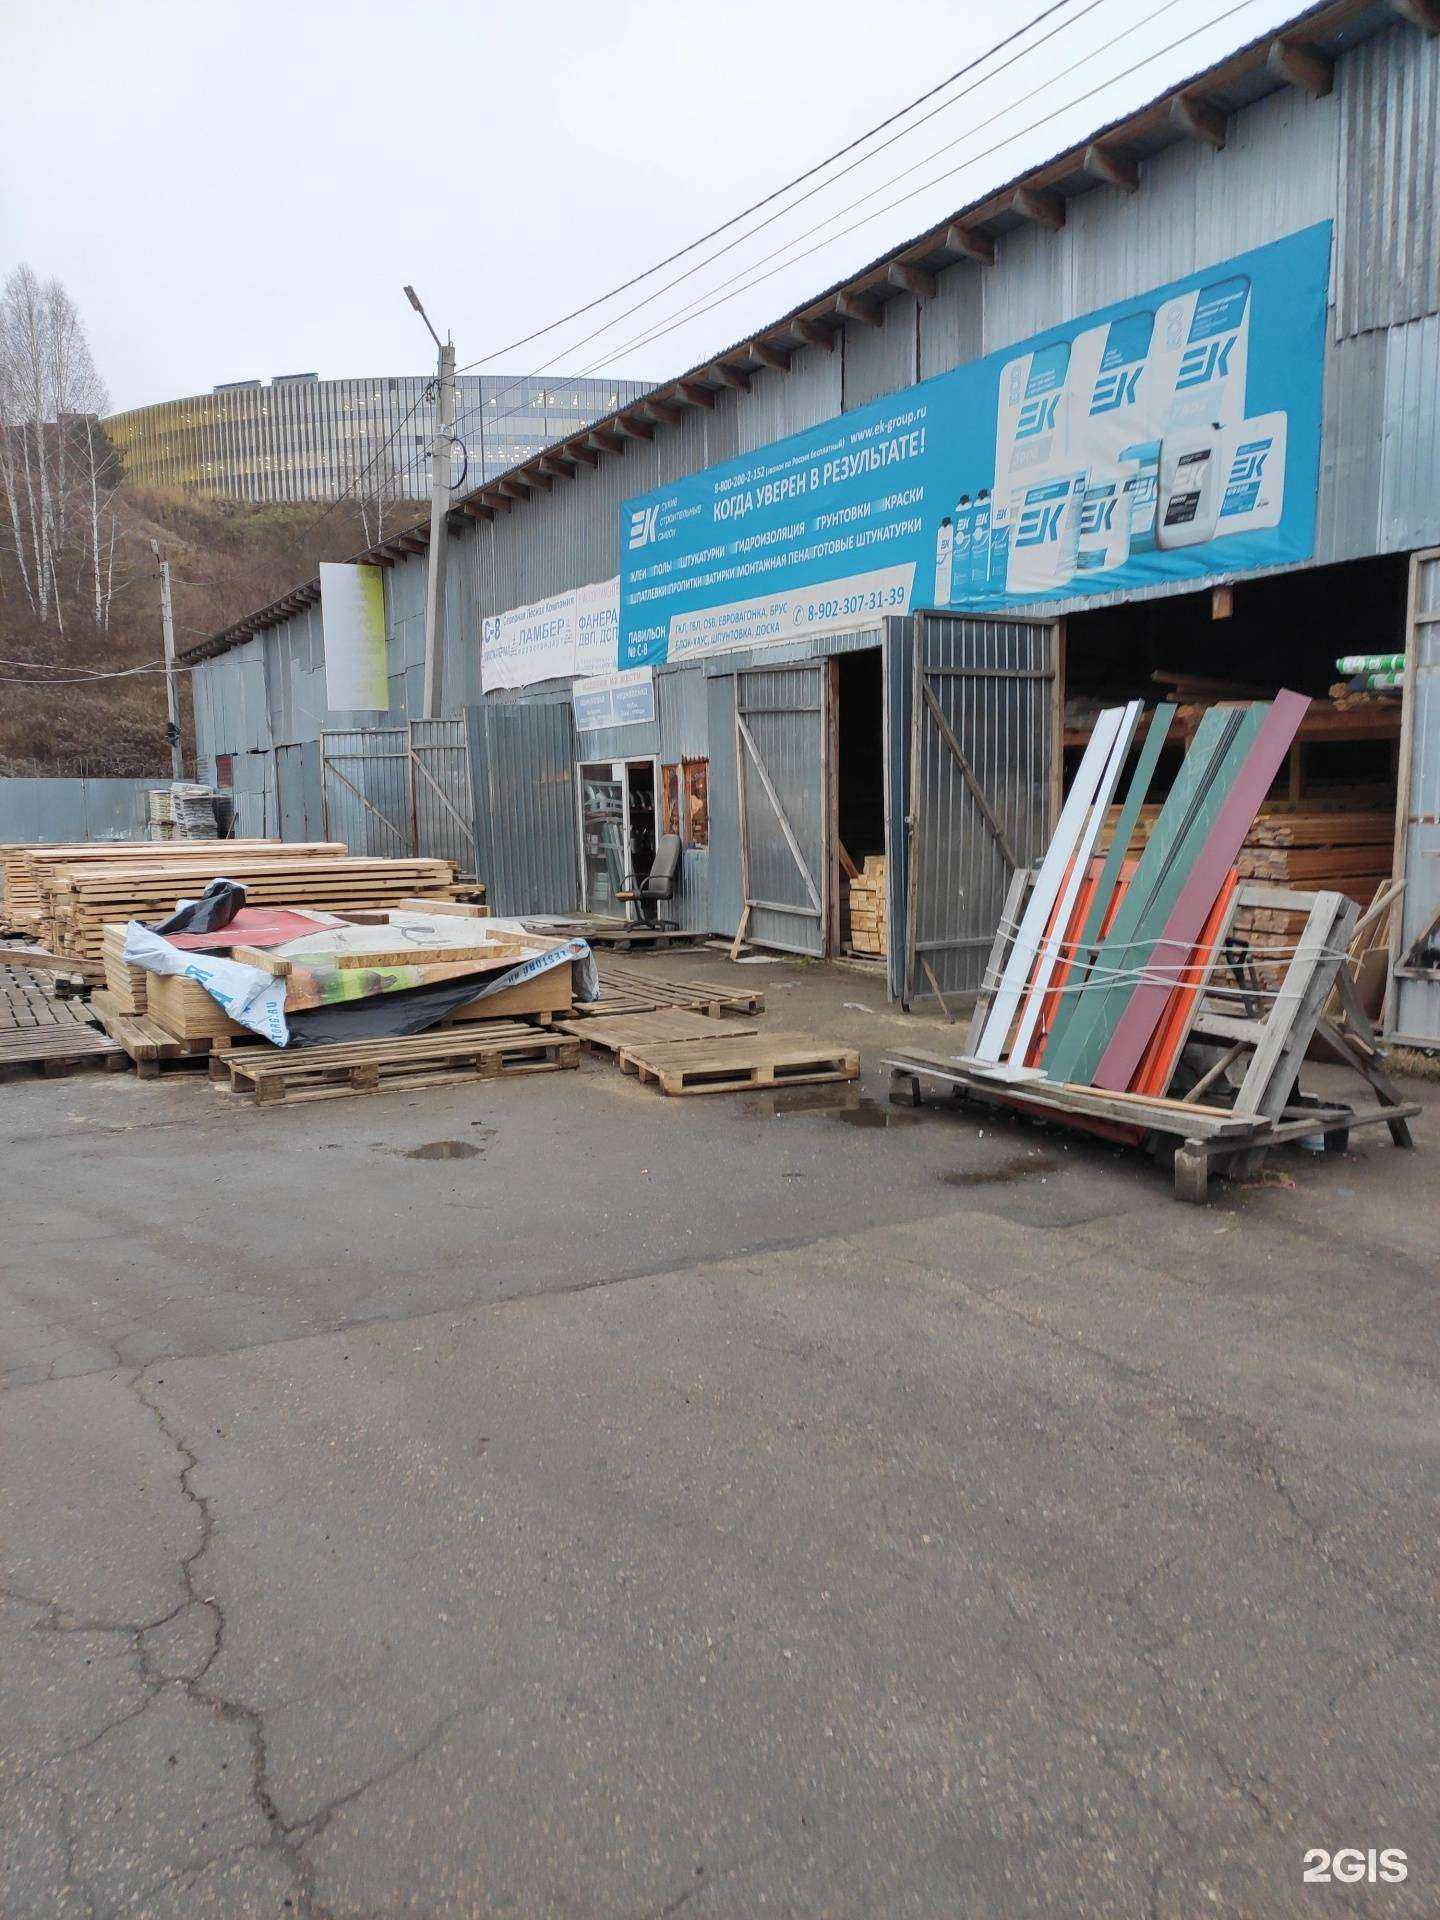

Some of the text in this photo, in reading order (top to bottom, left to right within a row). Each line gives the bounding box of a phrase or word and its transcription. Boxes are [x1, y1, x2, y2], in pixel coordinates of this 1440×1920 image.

[850, 406, 927, 444] www.ek-group.ru
[713, 427, 926, 522] КОГДА УВЕРЕН В РЕЗУЛЬТАТЕ!
[652, 561, 672, 577] ПОЛЫ
[679, 545, 726, 569] ШТУКАТУРКИ
[734, 522, 805, 553] ГИДРОИЗОЛЯЦИЯ
[816, 502, 871, 530] ГРУНТОВКИ
[884, 486, 924, 511] КРАСКИ
[669, 577, 702, 595] ПРОПИТКИ
[704, 567, 735, 586] ЗАТИРКИ
[737, 553, 787, 577] МОНТАЖНАЯ
[788, 549, 811, 565] ПЕНА
[813, 536, 854, 560] ГОТОВЫЕ
[856, 517, 922, 547] ШТУКАТУРКИ
[578, 608, 618, 630] ФАНЕРА
[769, 602, 788, 616] БРУС
[807, 586, 905, 621] 8-902-307-31-39
[520, 619, 565, 646] ЛАМБЕР
[627, 625, 666, 645] ПАВИЛЬОН
[755, 622, 780, 638] ДОСКА
